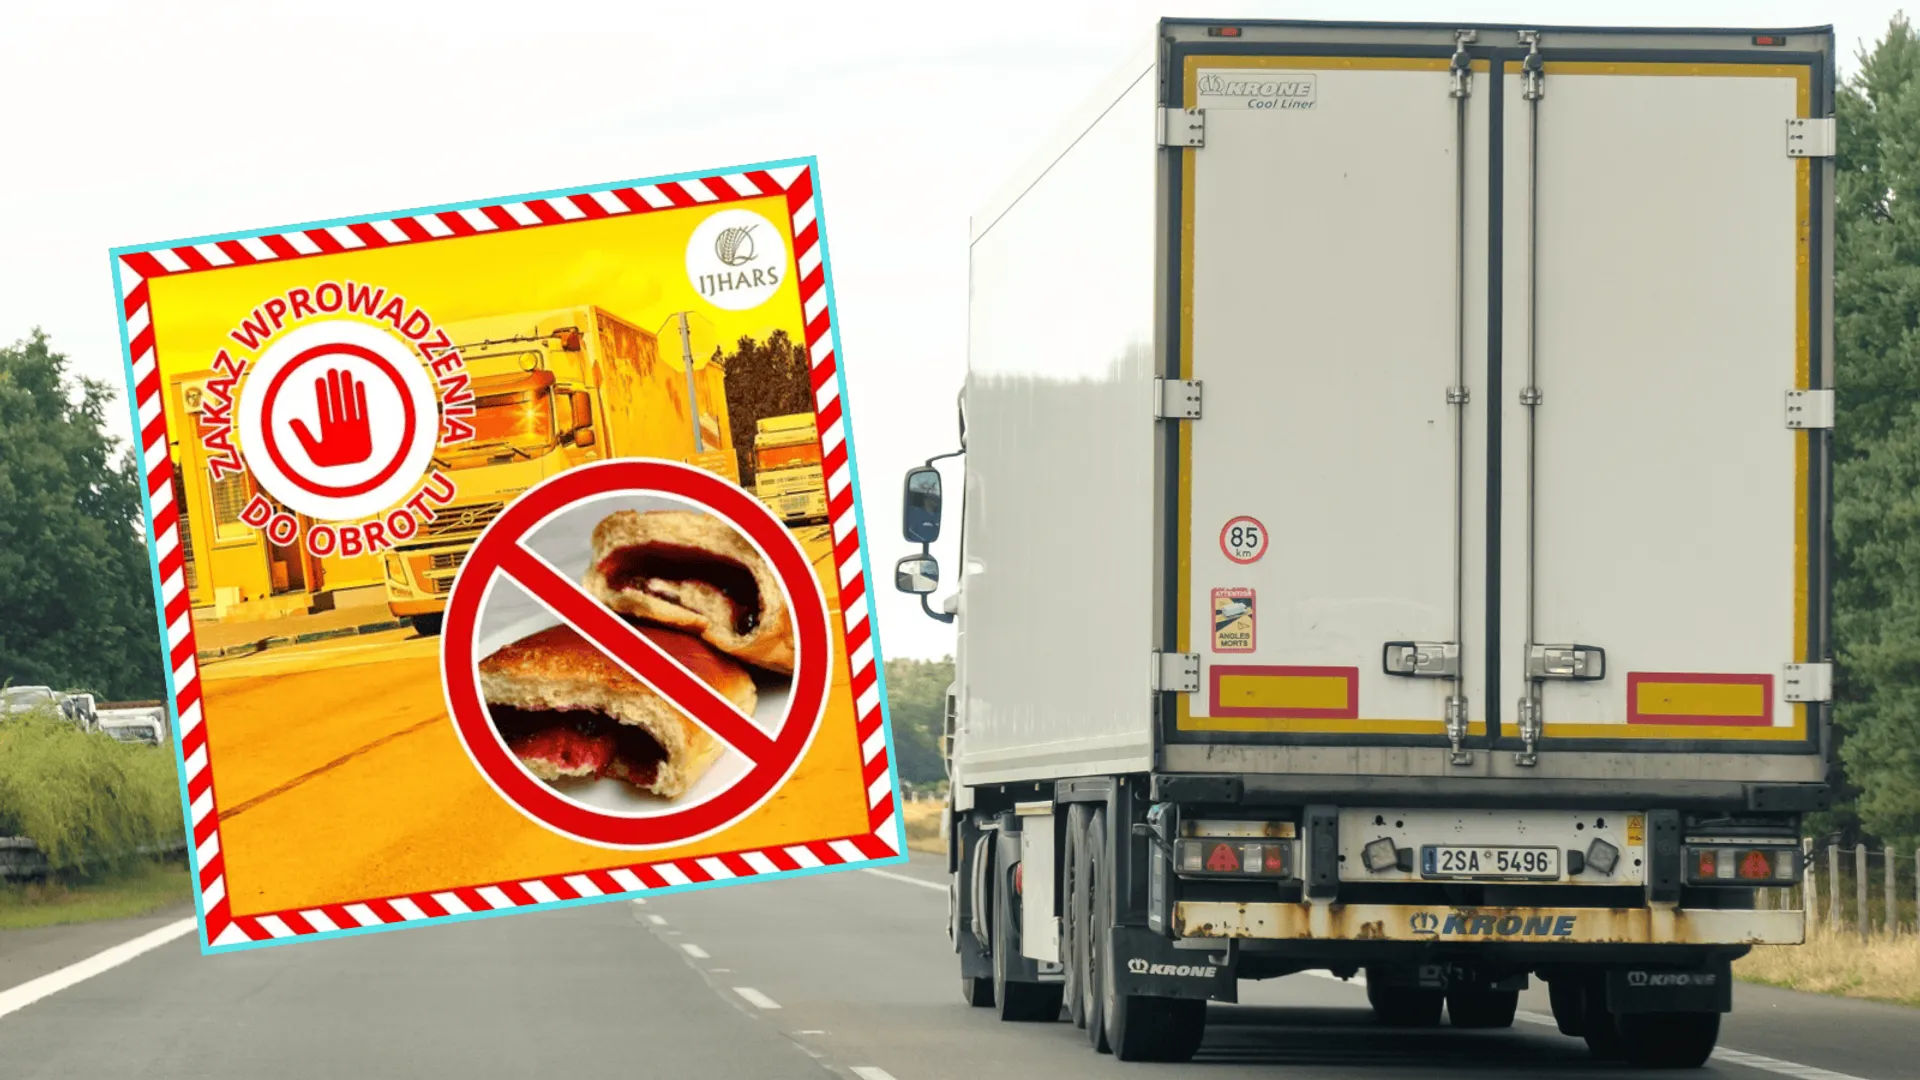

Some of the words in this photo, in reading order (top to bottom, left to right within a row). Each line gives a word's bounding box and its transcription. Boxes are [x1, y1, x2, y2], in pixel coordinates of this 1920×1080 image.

[1225, 81, 1312, 97] KRONE
[1247, 98, 1278, 109] Cool
[1281, 98, 1315, 109] Liner
[1230, 527, 1258, 548] 85
[1236, 548, 1252, 557] km
[1219, 632, 1251, 640] ANGLES
[1442, 850, 1479, 871] 2SA
[1497, 851, 1548, 872] 5496
[1442, 914, 1577, 936] KRONE
[1150, 963, 1217, 978] KRONE
